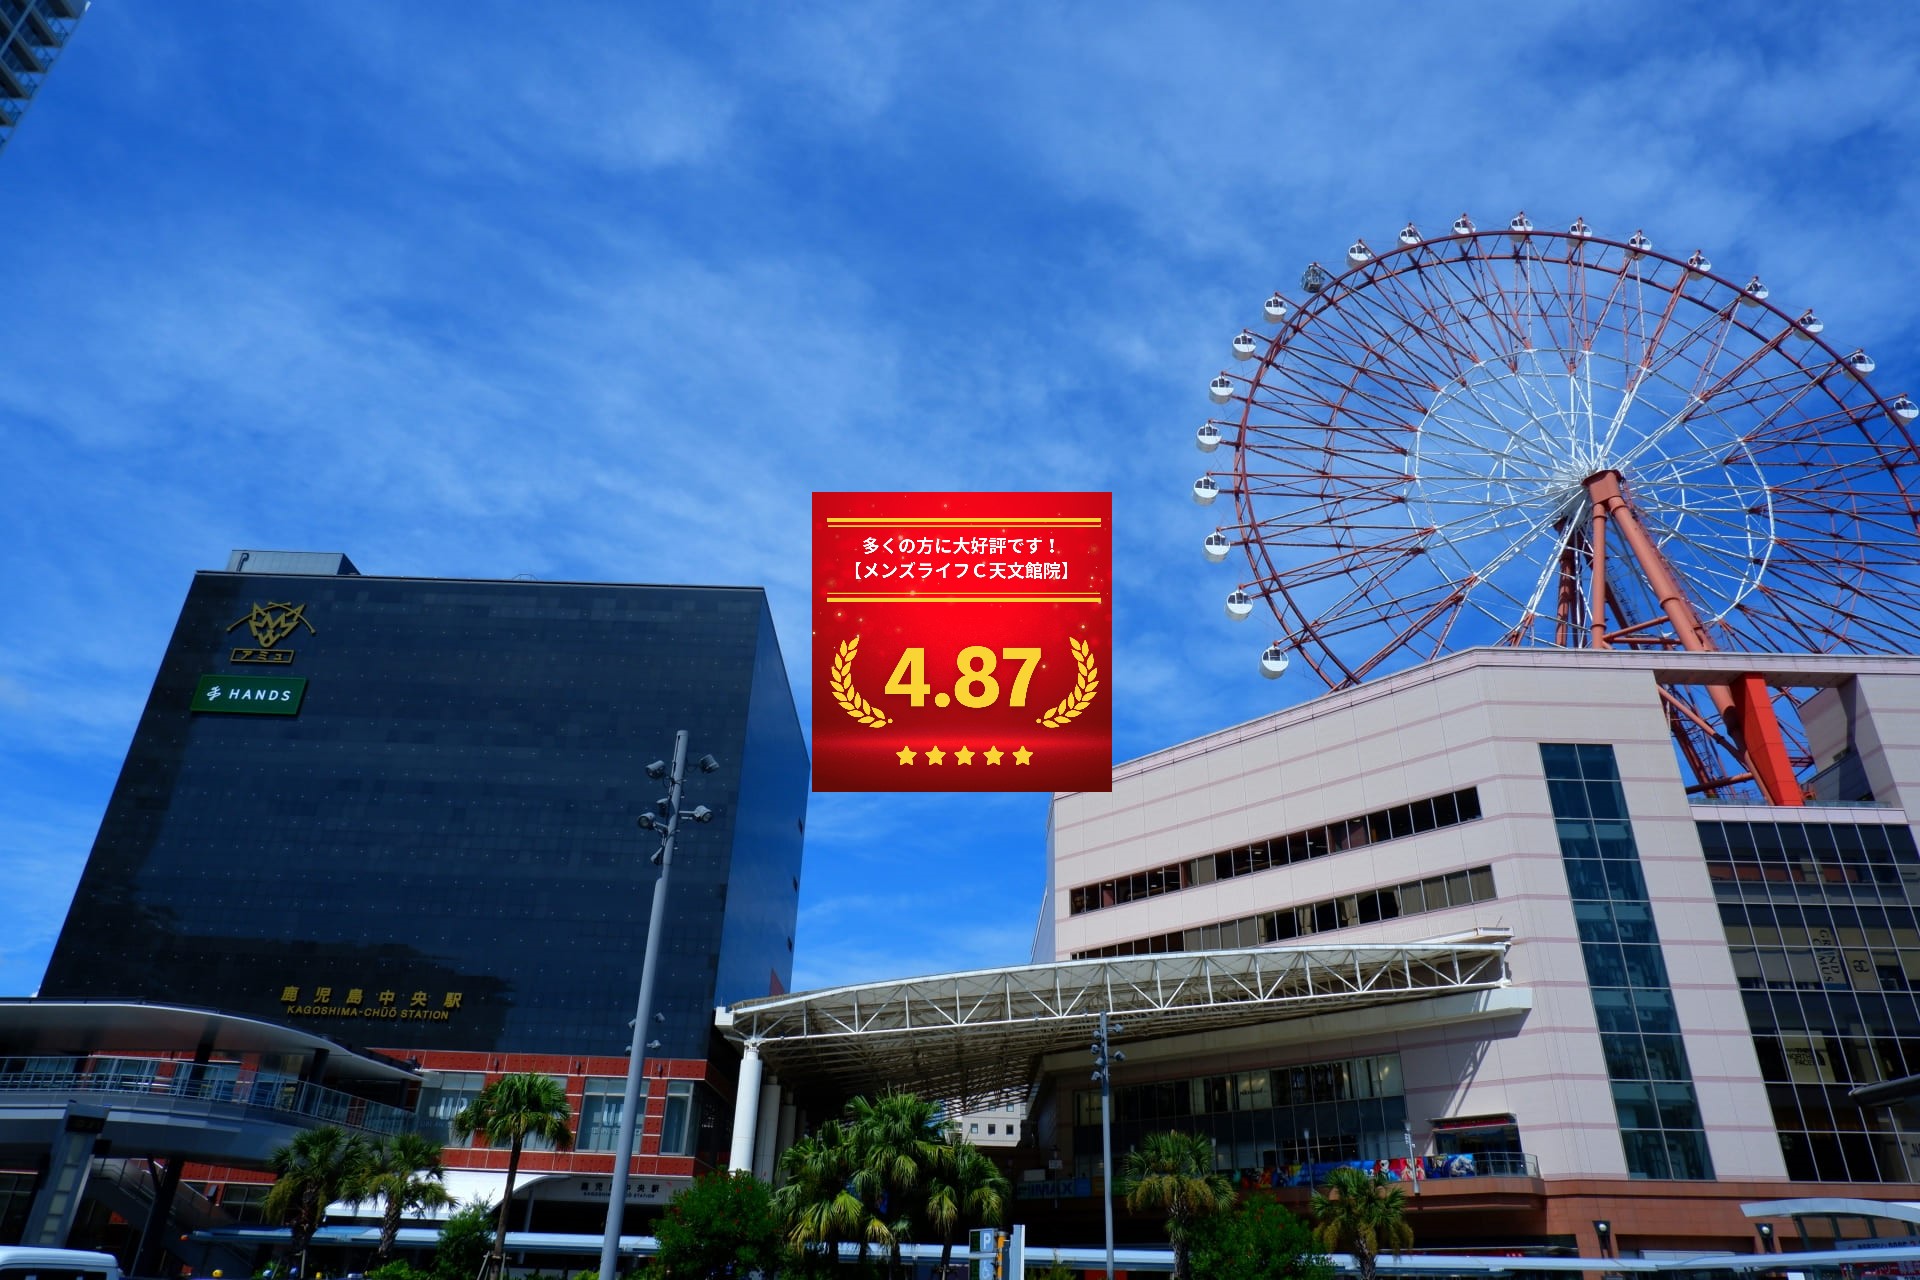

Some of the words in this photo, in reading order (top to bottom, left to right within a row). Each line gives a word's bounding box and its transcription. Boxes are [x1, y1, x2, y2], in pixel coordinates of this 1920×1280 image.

[228, 688, 291, 701] HANDS
[280, 985, 463, 1008] 鹿児島中央駅
[400, 1009, 449, 1020] STATION
[983, 1232, 992, 1250] P
